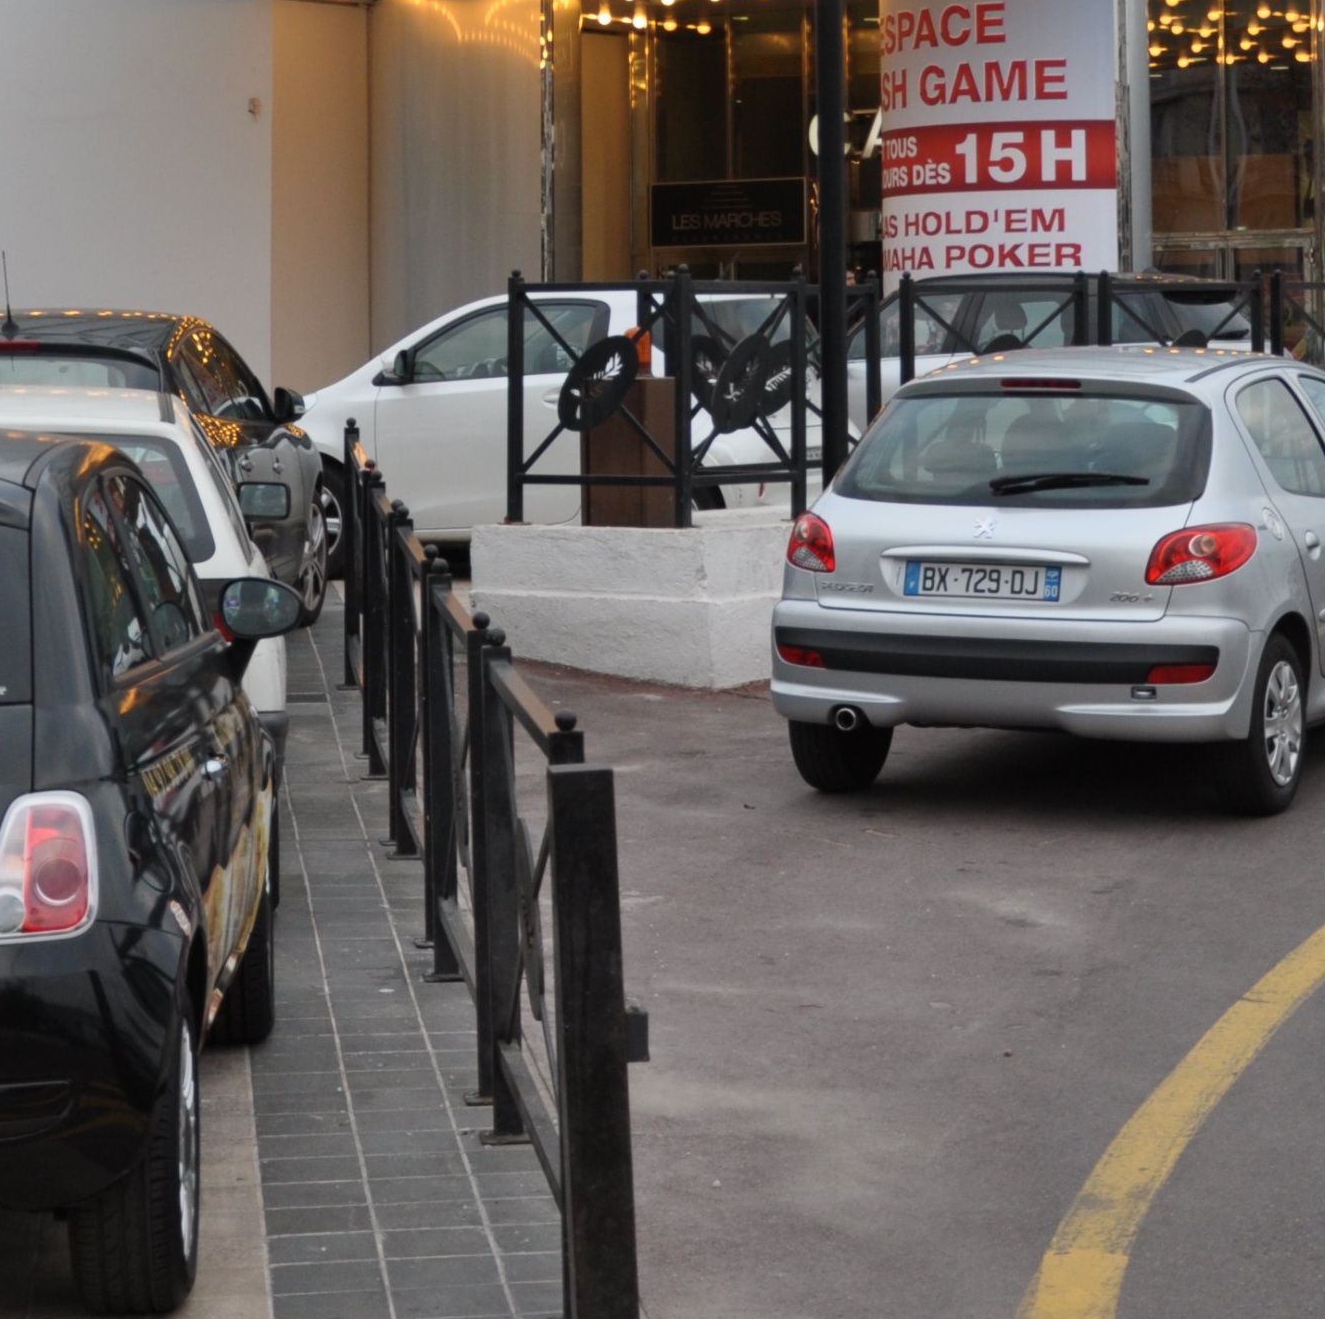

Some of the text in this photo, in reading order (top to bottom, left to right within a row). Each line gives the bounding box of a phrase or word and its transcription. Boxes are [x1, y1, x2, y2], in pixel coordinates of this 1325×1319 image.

[881, 58, 1068, 112] SH GAME
[882, 129, 1087, 190] OURS DÈS 15 H
[886, 136, 917, 160] TOUS
[672, 211, 782, 230] LES MARCHES
[904, 208, 1065, 237] HOLD'EM
[883, 243, 1082, 272] MAHA POKER
[1044, 585, 1058, 598] 60
